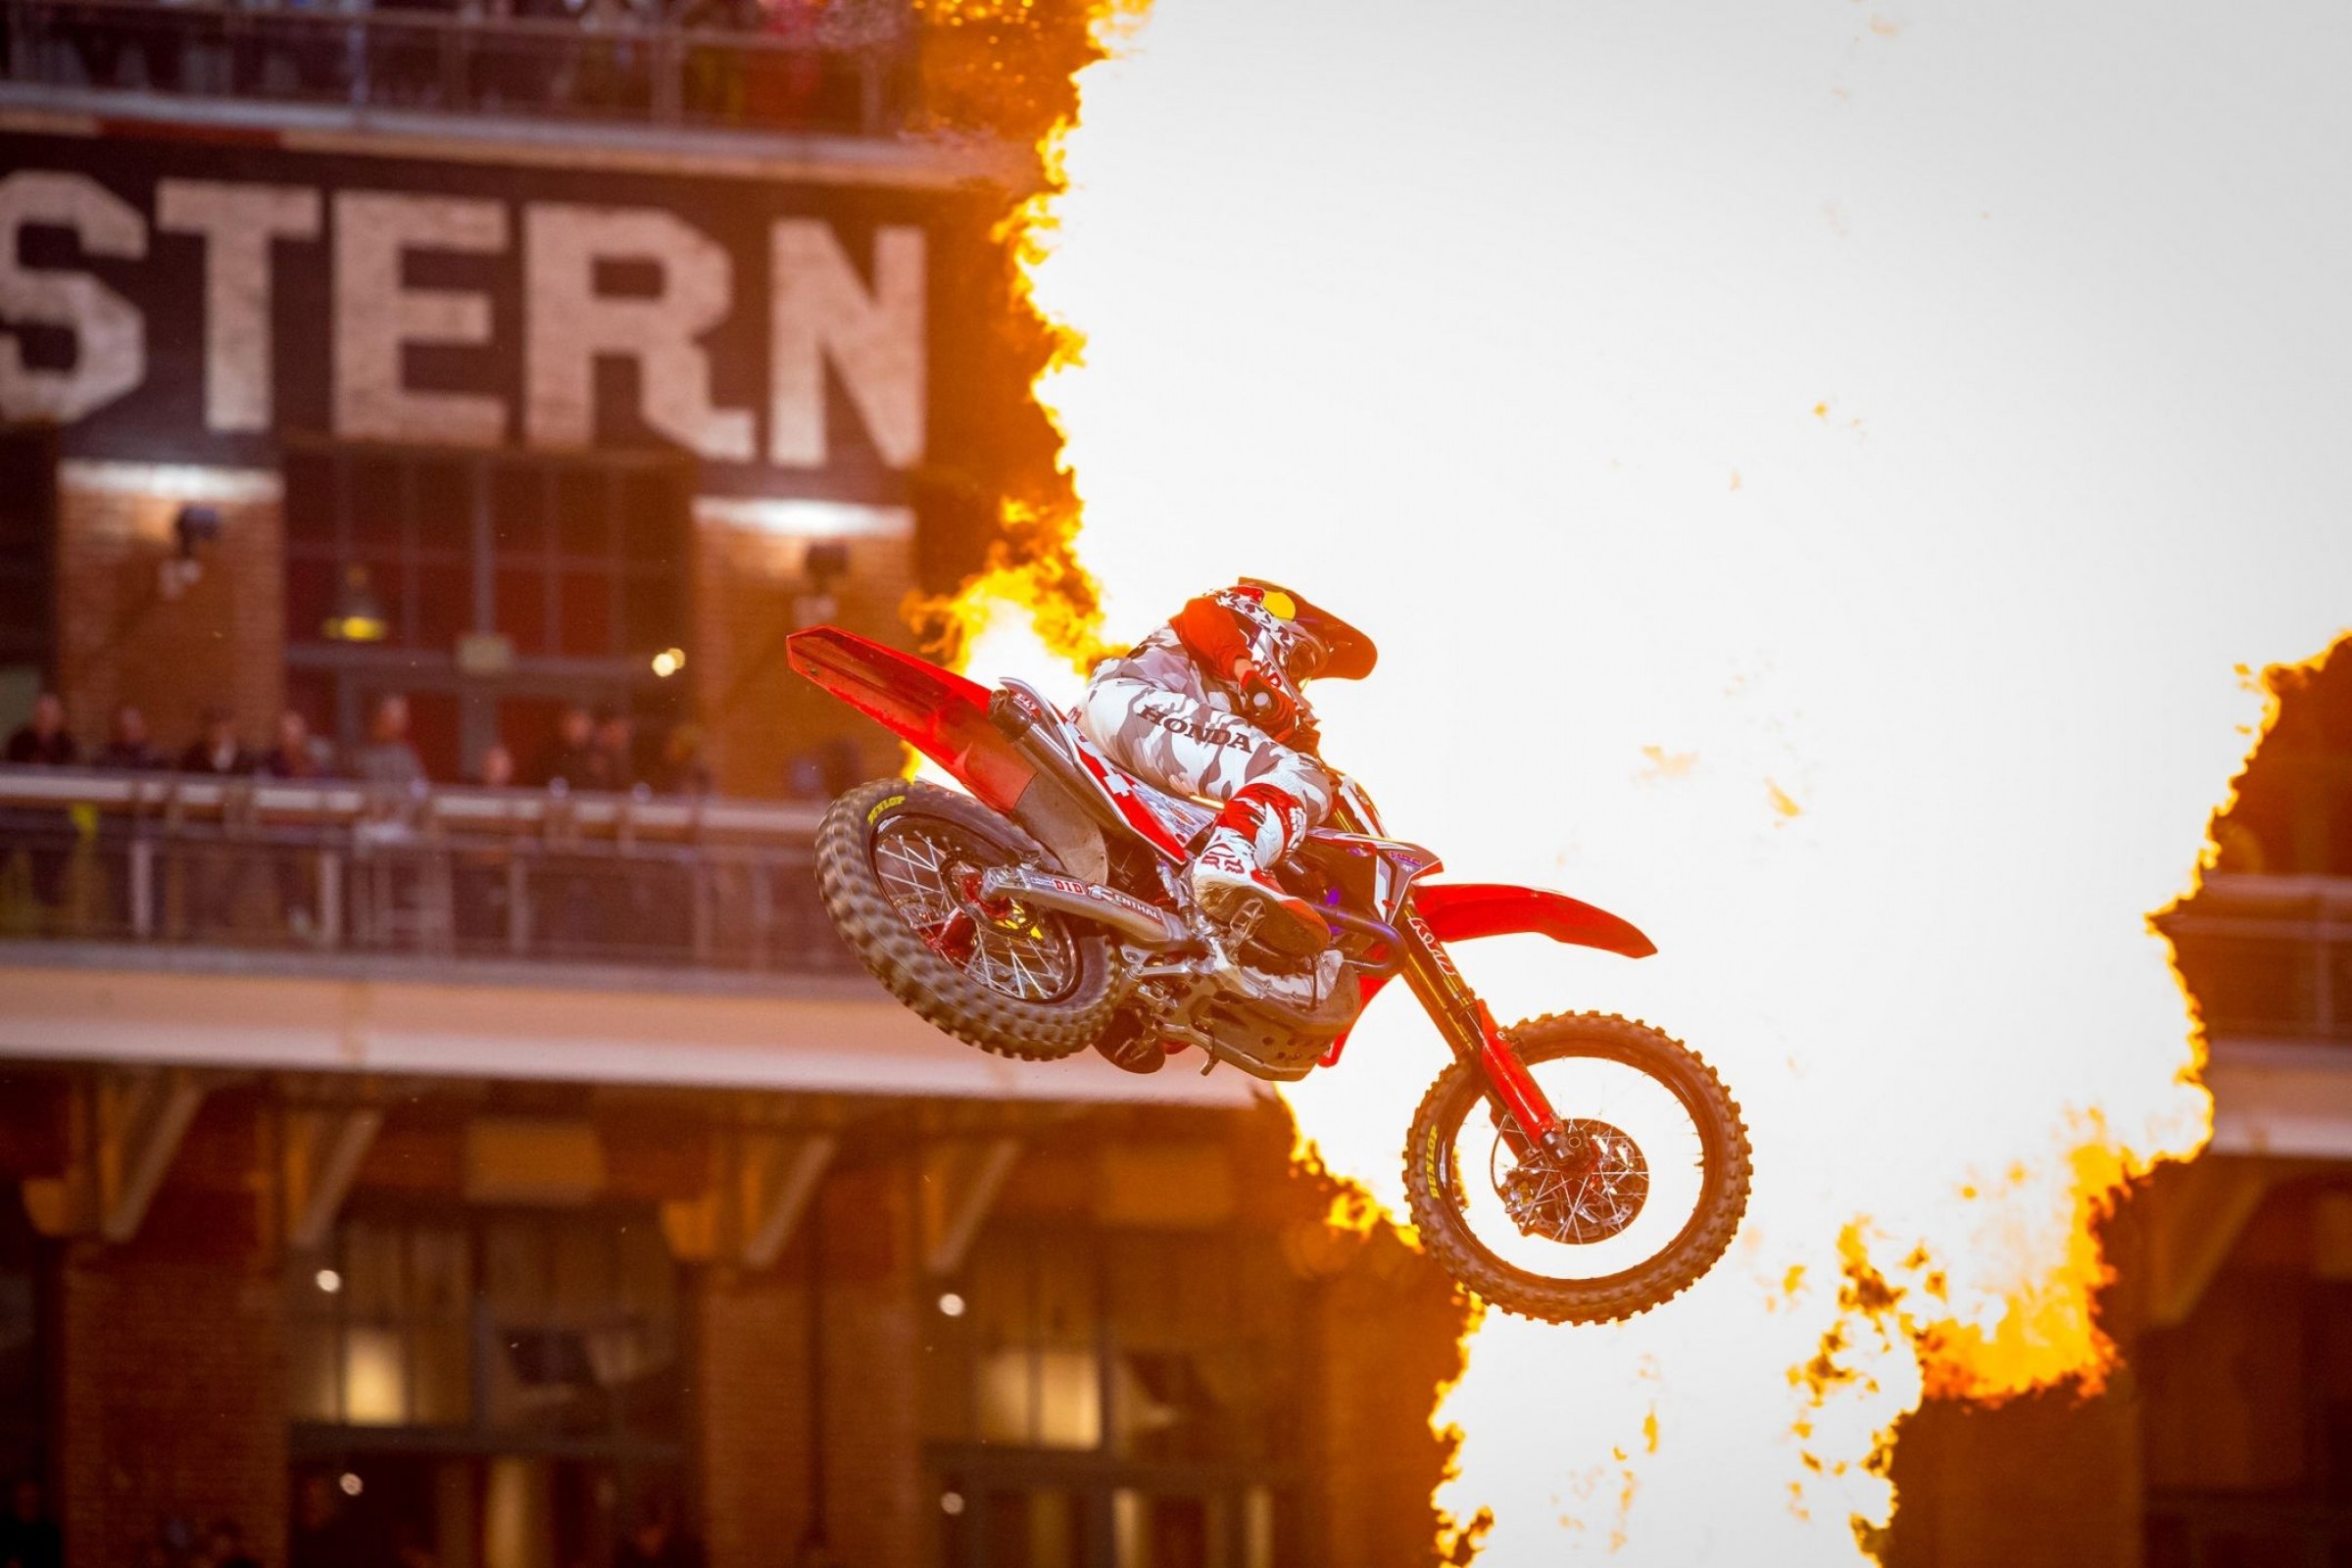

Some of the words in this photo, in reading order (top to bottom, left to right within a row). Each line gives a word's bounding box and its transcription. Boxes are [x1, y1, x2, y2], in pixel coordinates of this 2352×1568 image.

[0, 170, 927, 468] STERN
[1137, 704, 1252, 754] HONDA
[1426, 1123, 1441, 1200] DUNLOP
